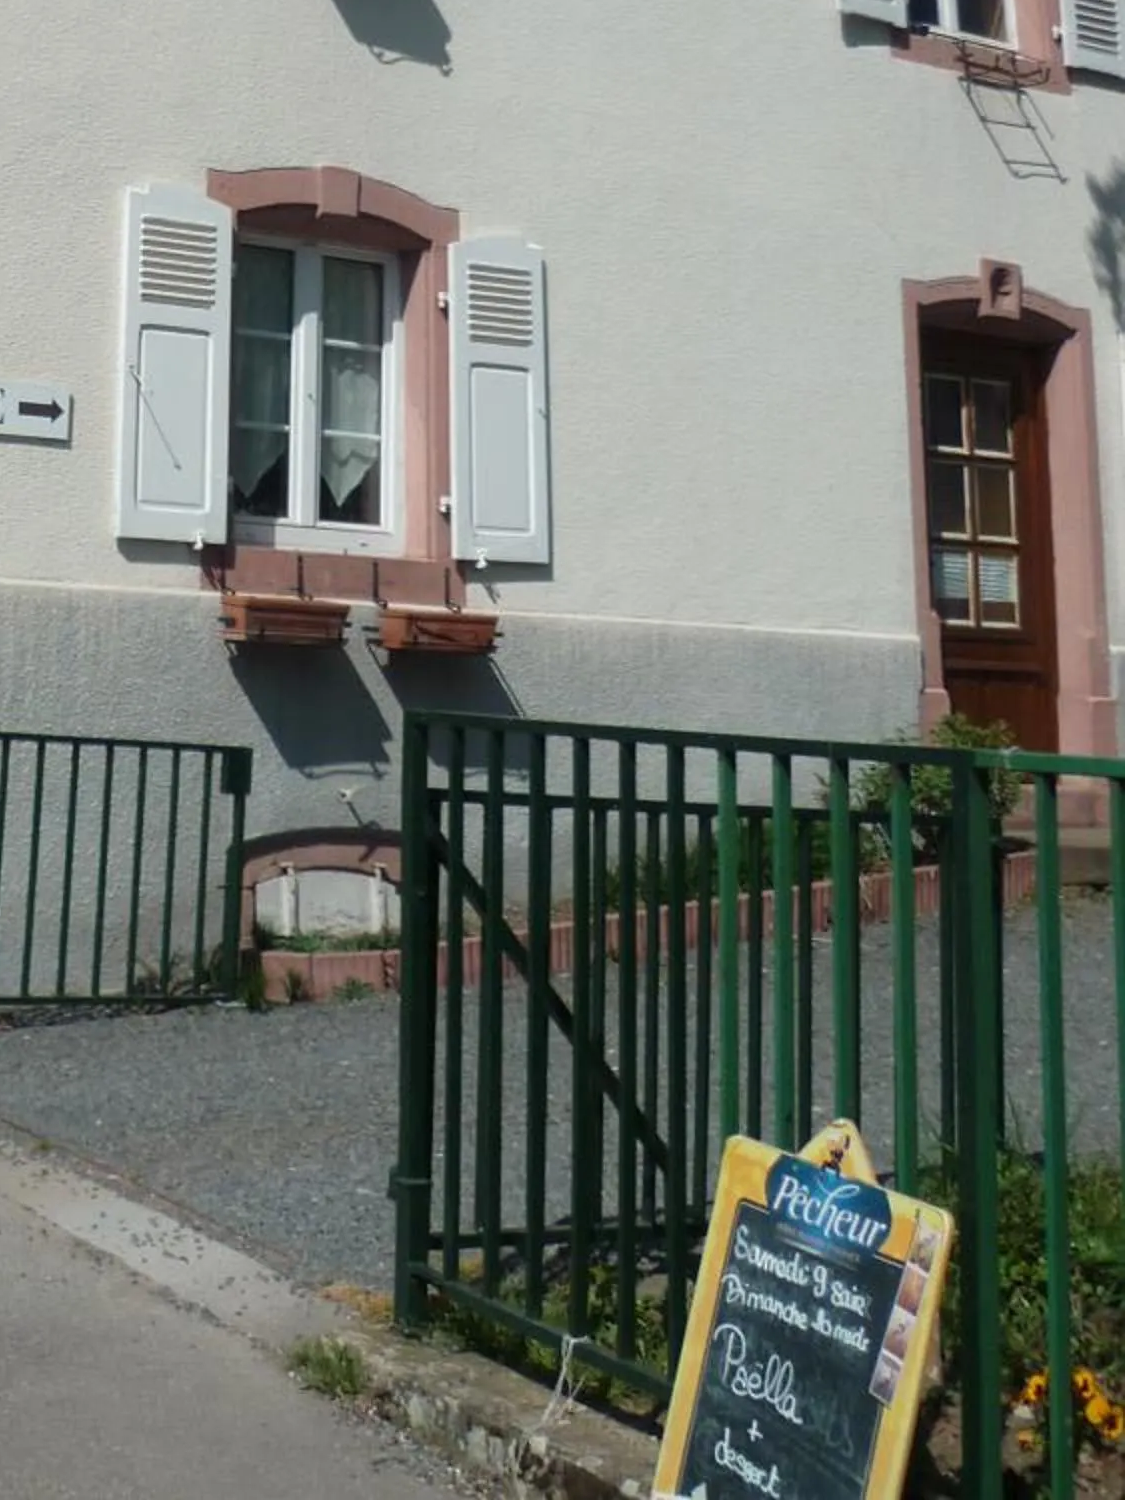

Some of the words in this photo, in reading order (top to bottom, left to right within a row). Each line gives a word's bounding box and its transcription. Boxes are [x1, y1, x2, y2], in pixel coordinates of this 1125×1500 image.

[773, 1173, 888, 1248] Pêcheur
[734, 1224, 809, 1286] Samedi
[721, 1273, 809, 1331] Dimanche
[714, 1427, 781, 1499] dessert
